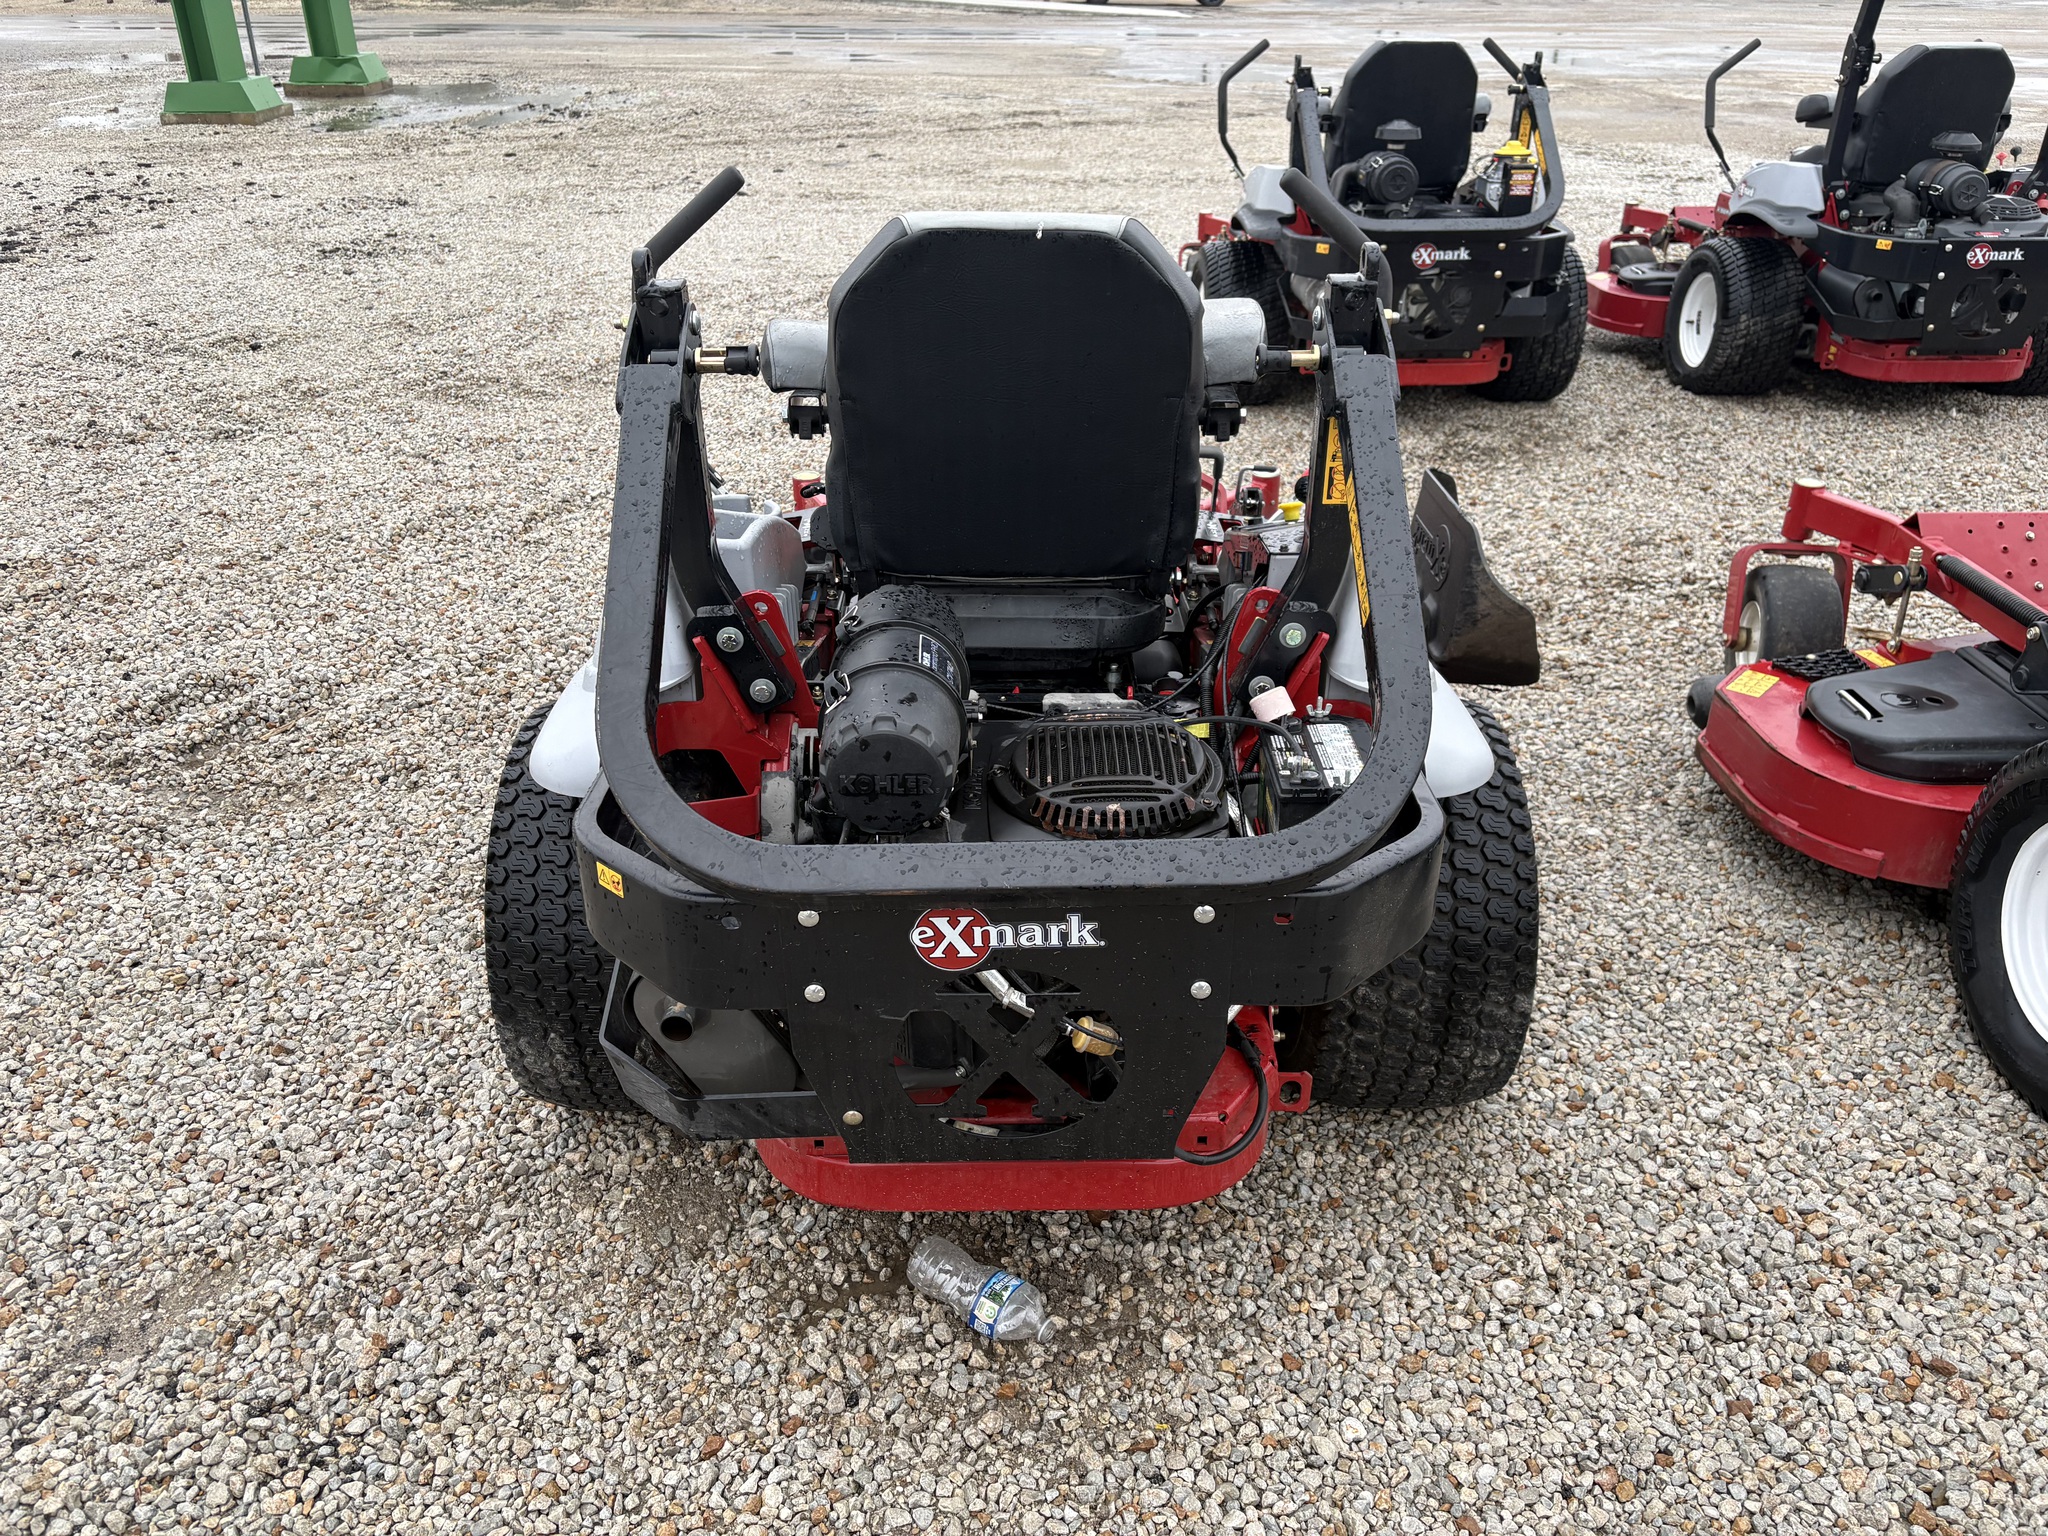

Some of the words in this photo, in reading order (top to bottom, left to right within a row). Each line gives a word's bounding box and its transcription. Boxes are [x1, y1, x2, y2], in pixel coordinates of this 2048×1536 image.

[1412, 246, 1470, 265] eXmark
[1966, 248, 2025, 265] eXmark
[839, 775, 935, 795] KOHLER
[911, 914, 1100, 958] eXmark
